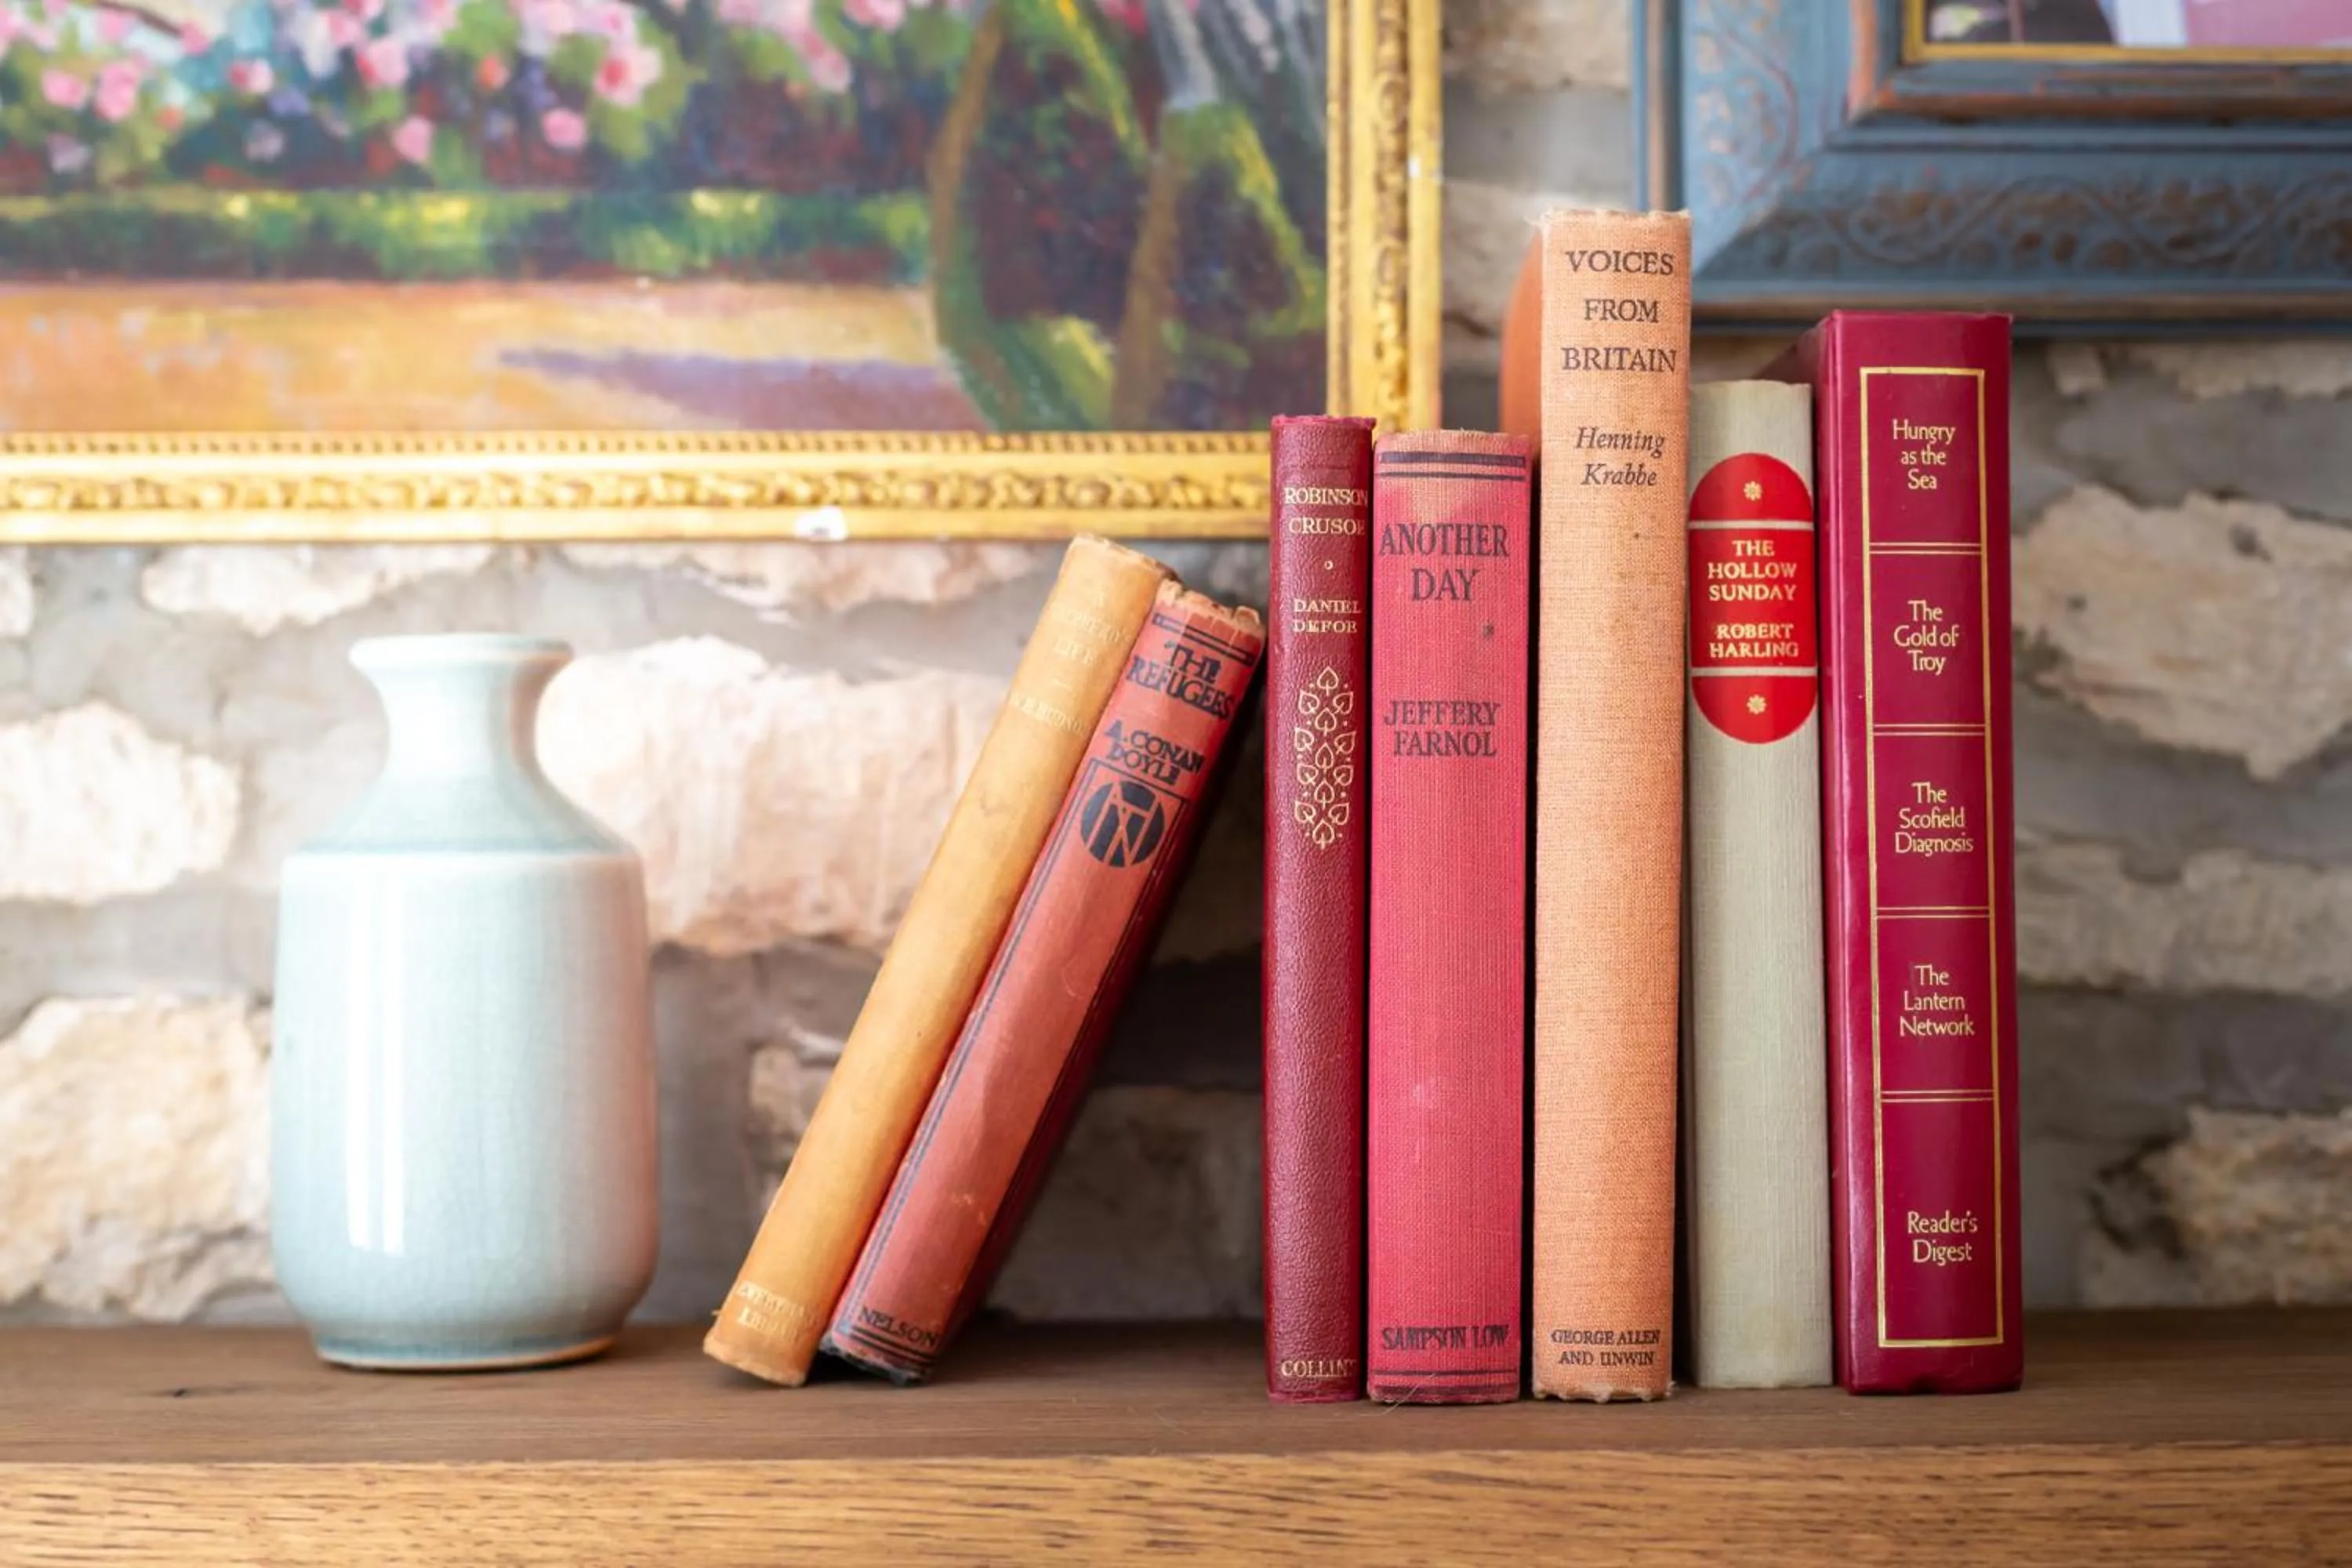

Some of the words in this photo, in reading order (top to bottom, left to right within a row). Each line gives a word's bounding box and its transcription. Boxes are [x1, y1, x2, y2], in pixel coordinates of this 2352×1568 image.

[1565, 249, 1674, 275] VOICES
[1584, 299, 1661, 323] FROM
[1561, 347, 1677, 372] BRITAIN
[1576, 426, 1665, 458] Henning
[1892, 419, 1956, 445] Hungry
[1900, 450, 1917, 465] as
[1921, 443, 1947, 466] the
[1581, 463, 1657, 486] Krabbe
[1907, 468, 1937, 490] Sea
[1283, 487, 1368, 506] ROBINSON
[1379, 524, 1509, 557] ANOTHER
[1732, 539, 1775, 557] THE
[1708, 561, 1797, 580] HOLLOW
[1411, 568, 1480, 601] DAY
[1708, 584, 1797, 601] SUNDAY
[1294, 599, 1361, 614] DANIEL
[1907, 599, 1943, 622] The
[1294, 619, 1357, 633] DEFOE
[1715, 623, 1794, 640] ROBERT
[1893, 624, 1936, 647] Gold
[1940, 624, 1960, 647] of
[1164, 640, 1221, 684] THE
[1709, 642, 1798, 659] HARLING
[1907, 650, 1947, 676] Troy
[1126, 655, 1238, 720] REFUGEES
[1383, 700, 1501, 726] JEFFERY
[1131, 729, 1205, 775] CONAN
[1393, 730, 1497, 757] FARNOL
[1106, 742, 1181, 786] DOYLE
[1911, 782, 1947, 803] The
[1899, 806, 1965, 829] Scofield
[1894, 831, 1974, 856] Diagnosis
[1915, 964, 1949, 985] The
[1904, 991, 1965, 1011] Lantern
[1900, 1014, 1975, 1037] Network
[1907, 1210, 1978, 1234] Reader's
[1913, 1239, 1973, 1266] Digest
[858, 1306, 938, 1348] NELSON
[1381, 1326, 1467, 1351] SAMPSON
[1471, 1324, 1510, 1349] LOW
[1551, 1329, 1615, 1345] GEORGE
[1616, 1329, 1661, 1345] ALLEN
[1558, 1351, 1595, 1366] AND
[1600, 1351, 1656, 1366] UNWIN
